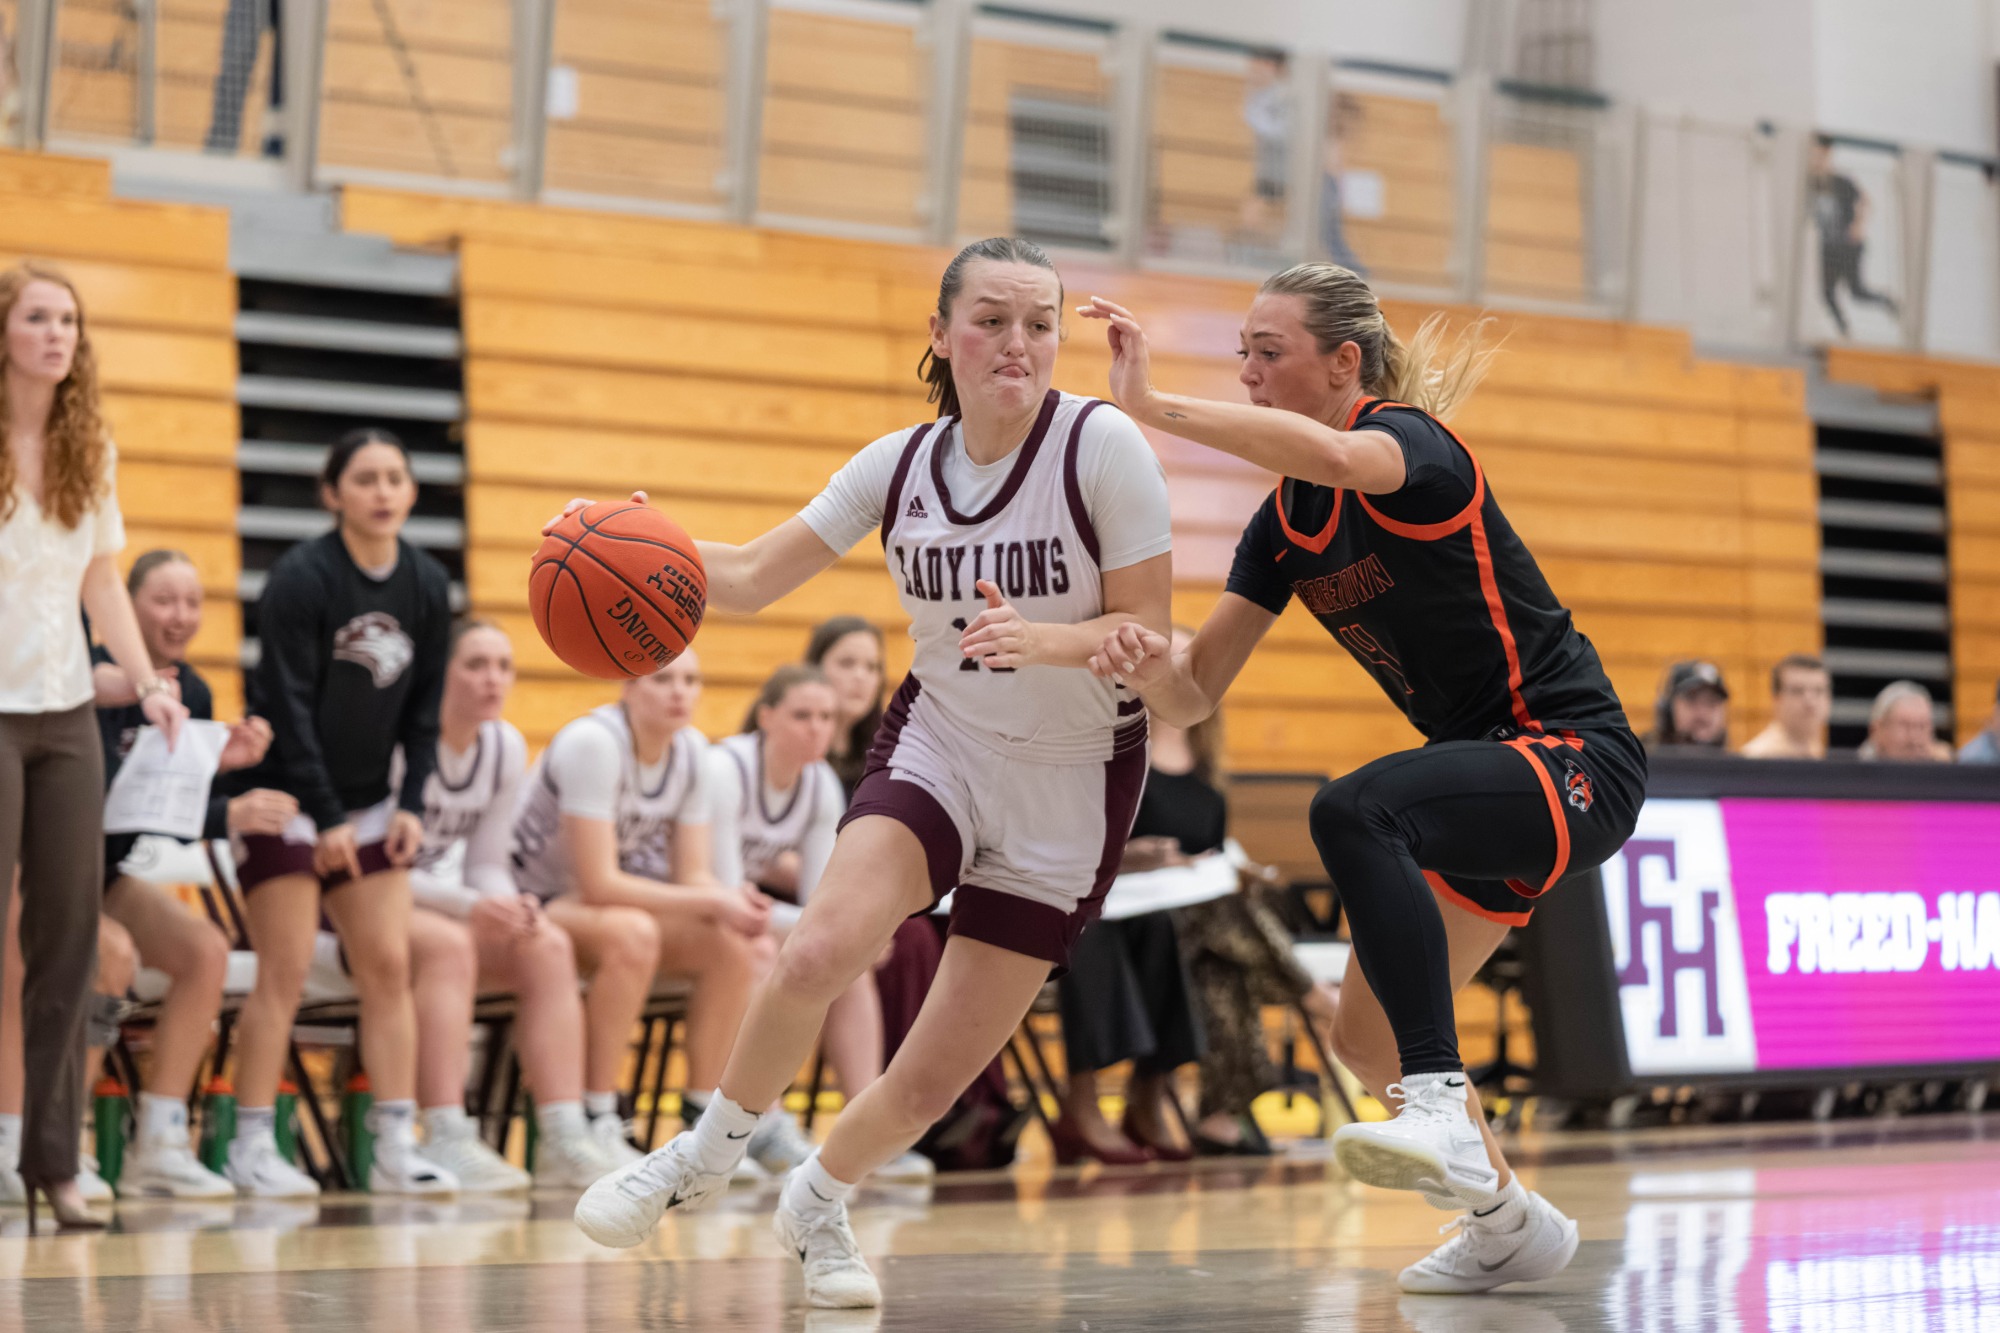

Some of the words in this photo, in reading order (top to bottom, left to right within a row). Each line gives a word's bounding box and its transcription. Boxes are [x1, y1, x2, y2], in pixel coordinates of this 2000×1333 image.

[646, 572, 702, 628] EGACY
[894, 545, 968, 602] LADY
[973, 536, 1071, 599] LIONS
[606, 596, 678, 668] PALDING
